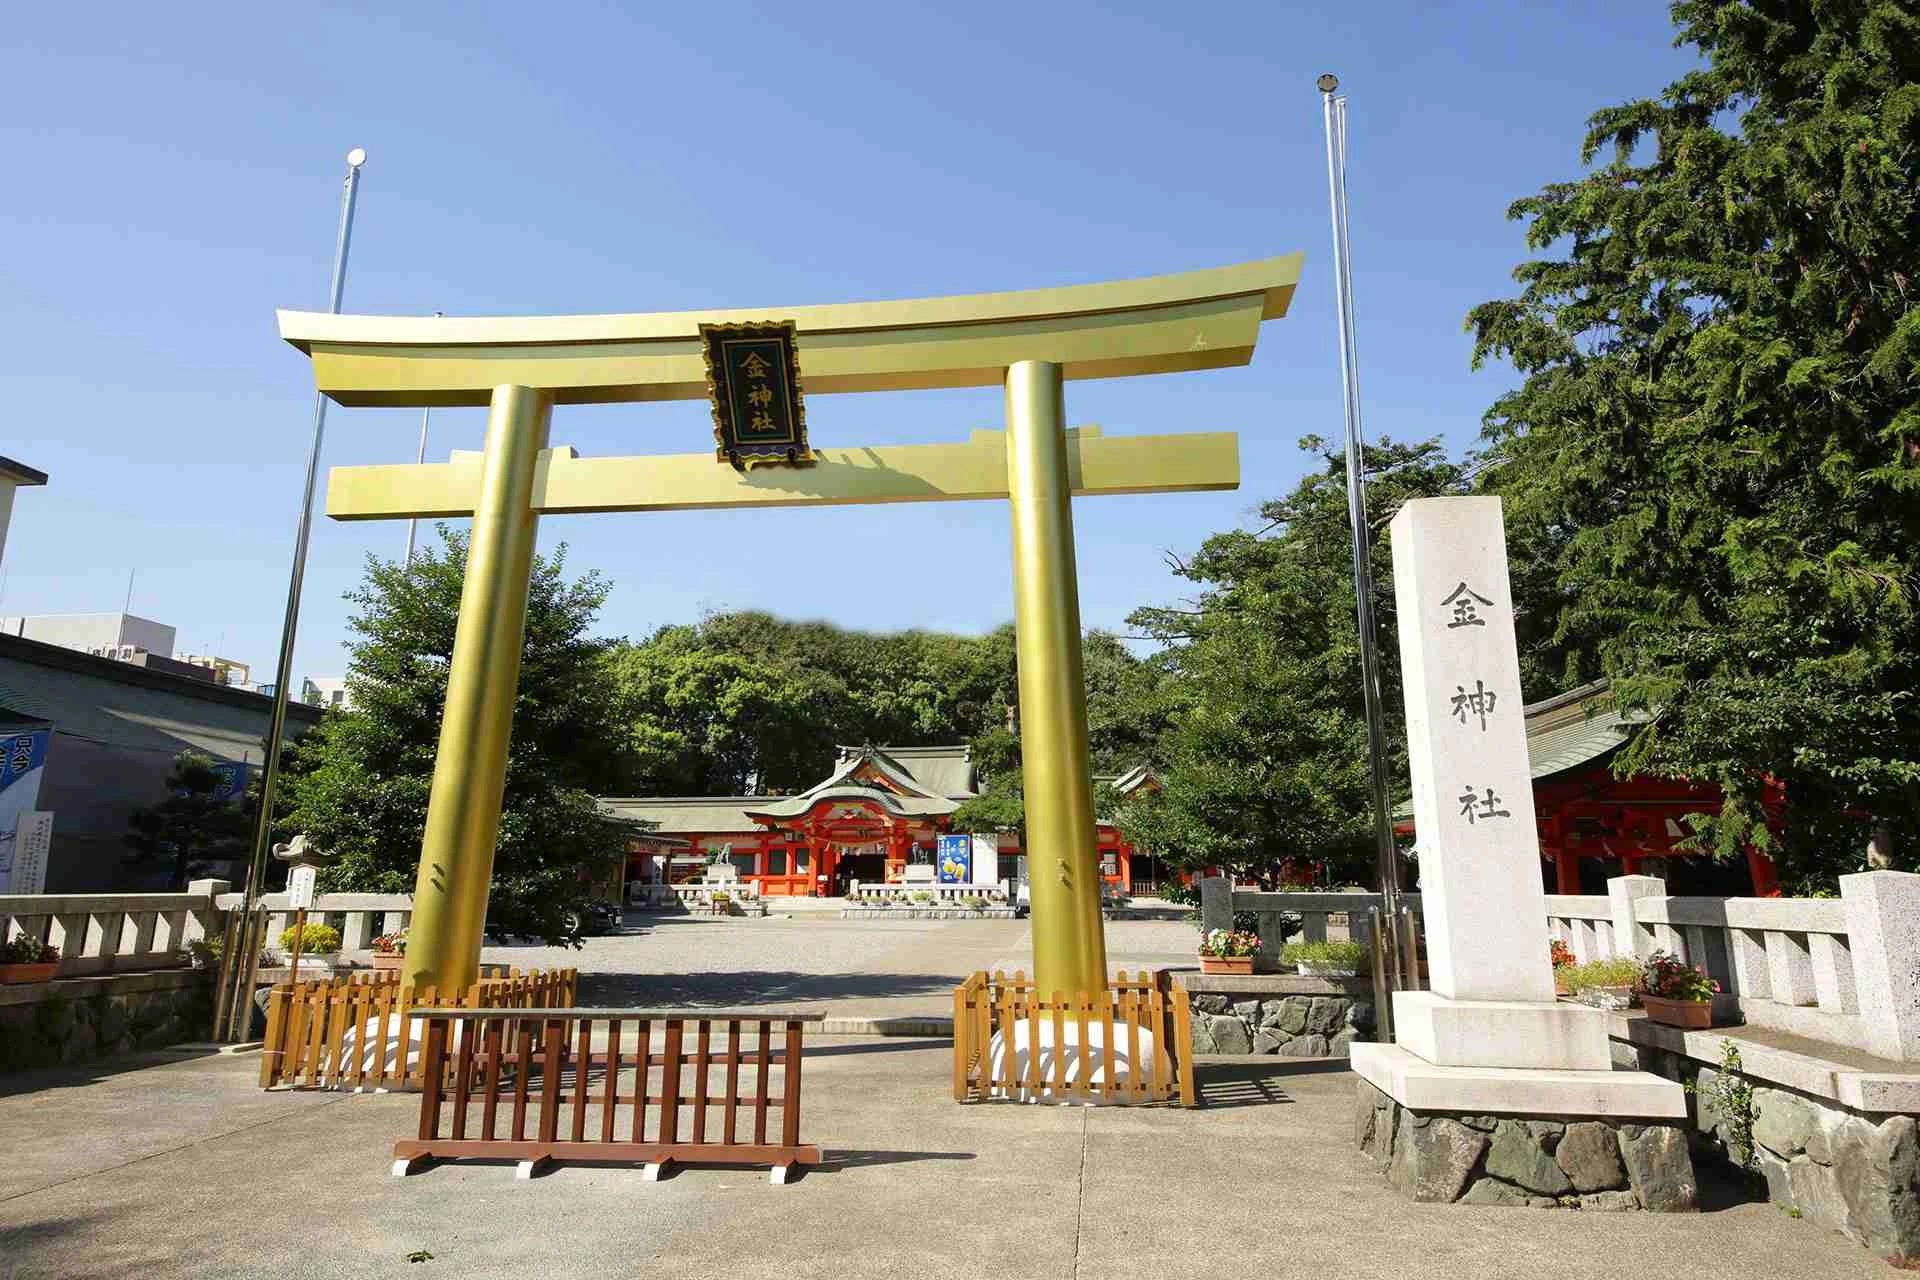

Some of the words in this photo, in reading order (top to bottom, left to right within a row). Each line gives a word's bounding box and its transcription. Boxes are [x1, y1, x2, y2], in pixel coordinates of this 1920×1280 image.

[738, 351, 777, 433] 金神社
[1440, 581, 1511, 824] 金神社
